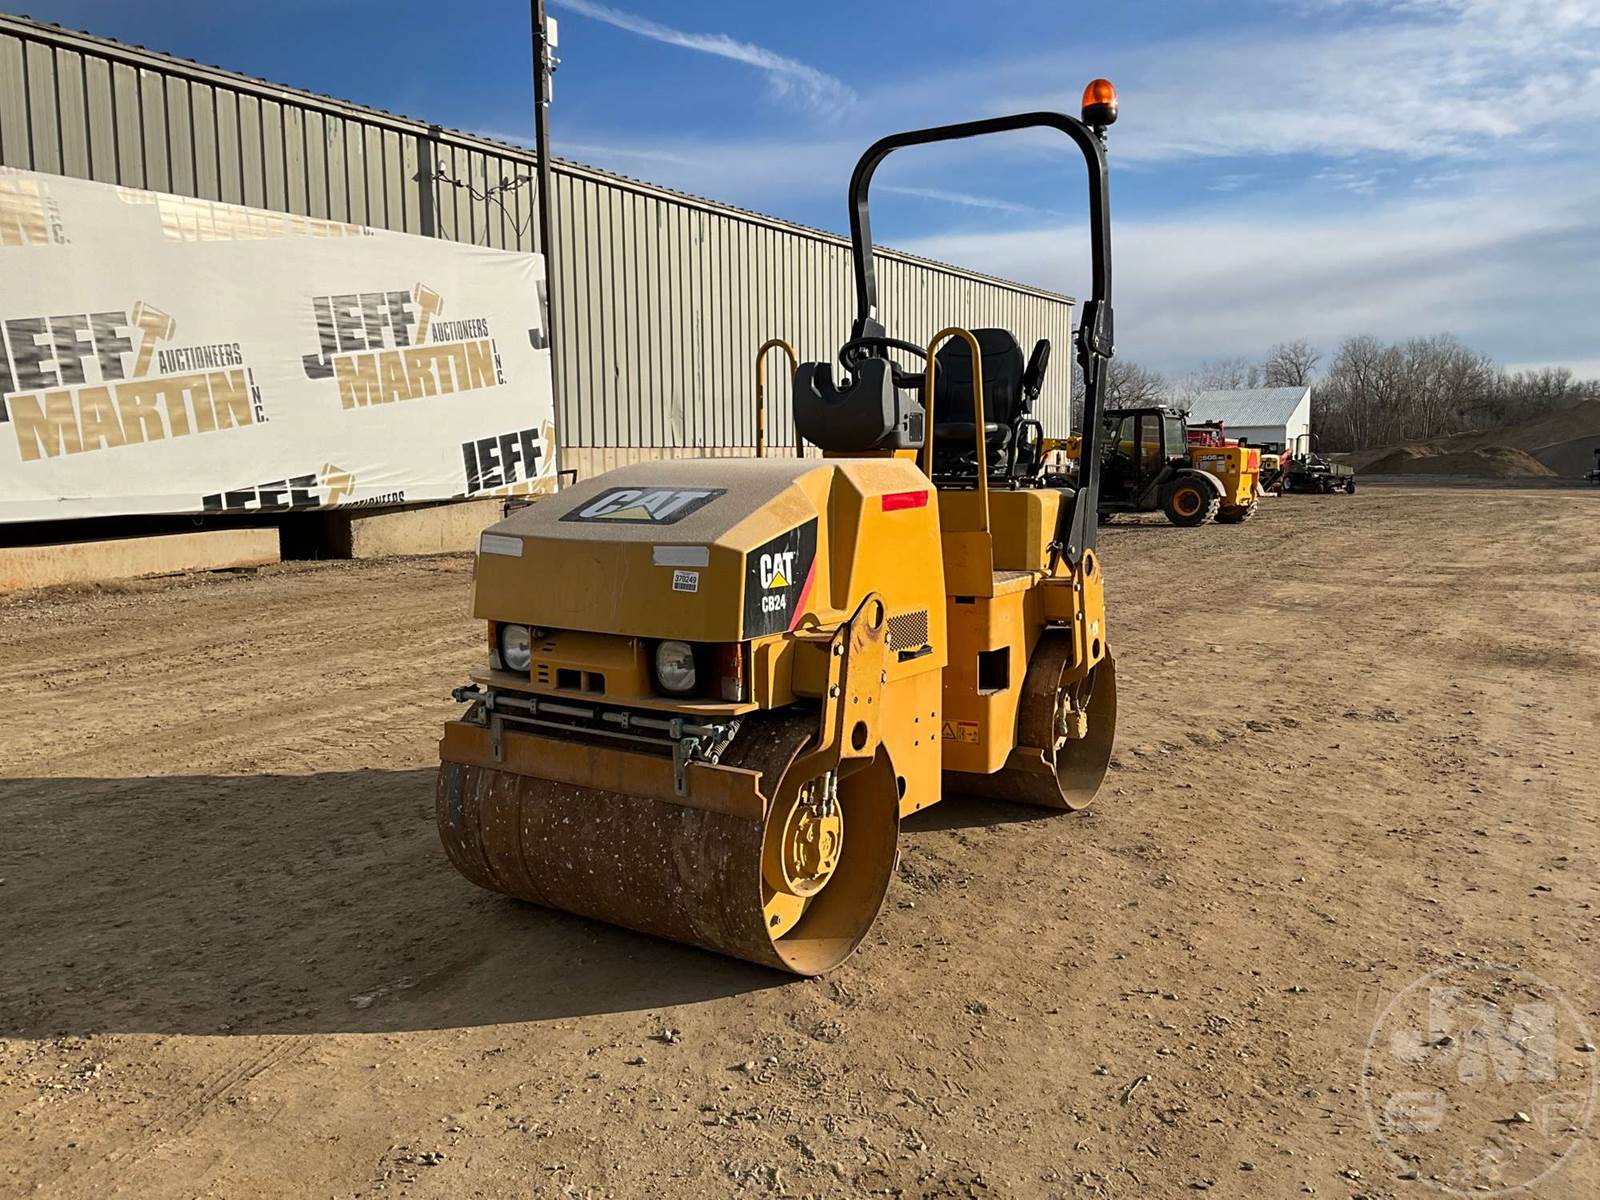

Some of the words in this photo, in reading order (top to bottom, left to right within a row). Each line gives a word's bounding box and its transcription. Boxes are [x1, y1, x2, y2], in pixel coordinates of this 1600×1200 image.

[302, 291, 415, 379] JEFF
[432, 318, 489, 342] AUCTIONEERS
[0, 311, 133, 423] EFF
[158, 342, 243, 374] AUCTIONEERS
[334, 340, 496, 410] MARTIN
[492, 339, 507, 384] INC.
[8, 369, 252, 462] MARTIN
[247, 368, 269, 423] INC.
[579, 489, 711, 520] CAT
[760, 552, 793, 589] CAT
[761, 593, 787, 613] CB24
